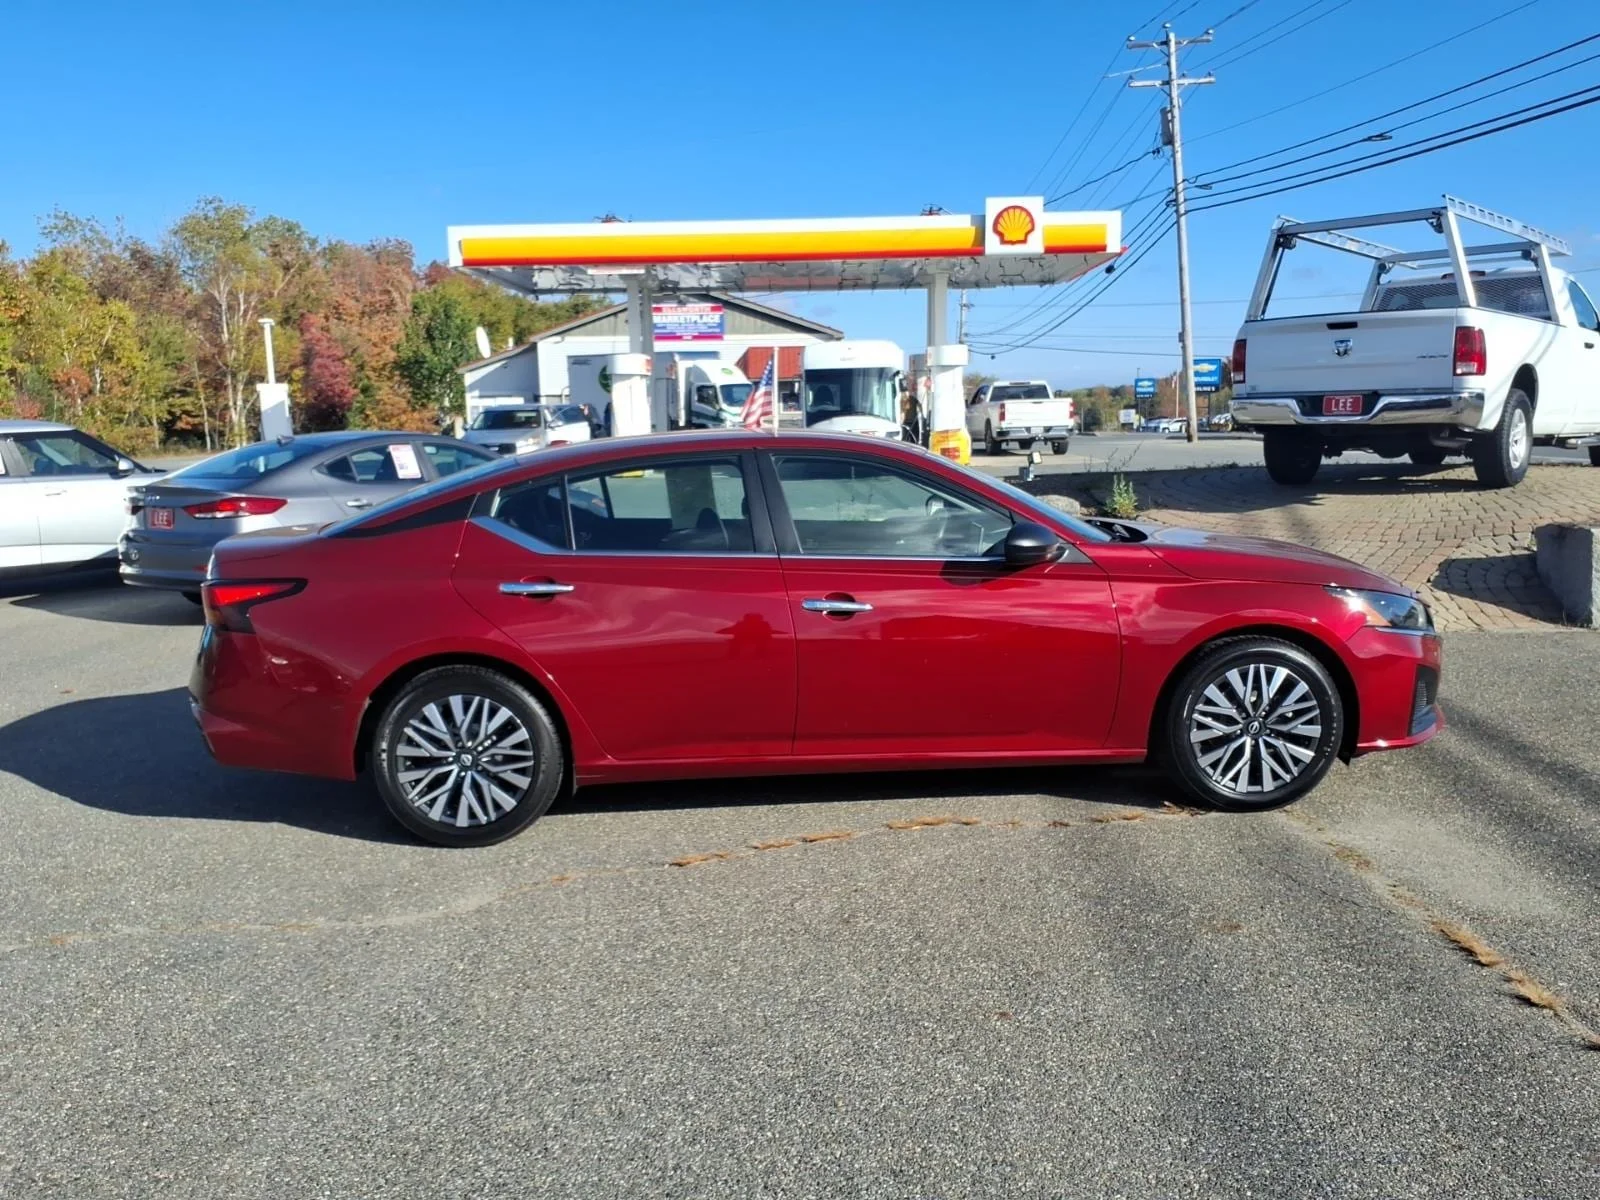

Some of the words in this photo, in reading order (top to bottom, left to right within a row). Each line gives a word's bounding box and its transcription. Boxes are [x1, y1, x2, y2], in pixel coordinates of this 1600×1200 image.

[652, 314, 721, 324] MARKETPLACE
[1331, 398, 1353, 411] LEE
[154, 511, 168, 525] LEE
